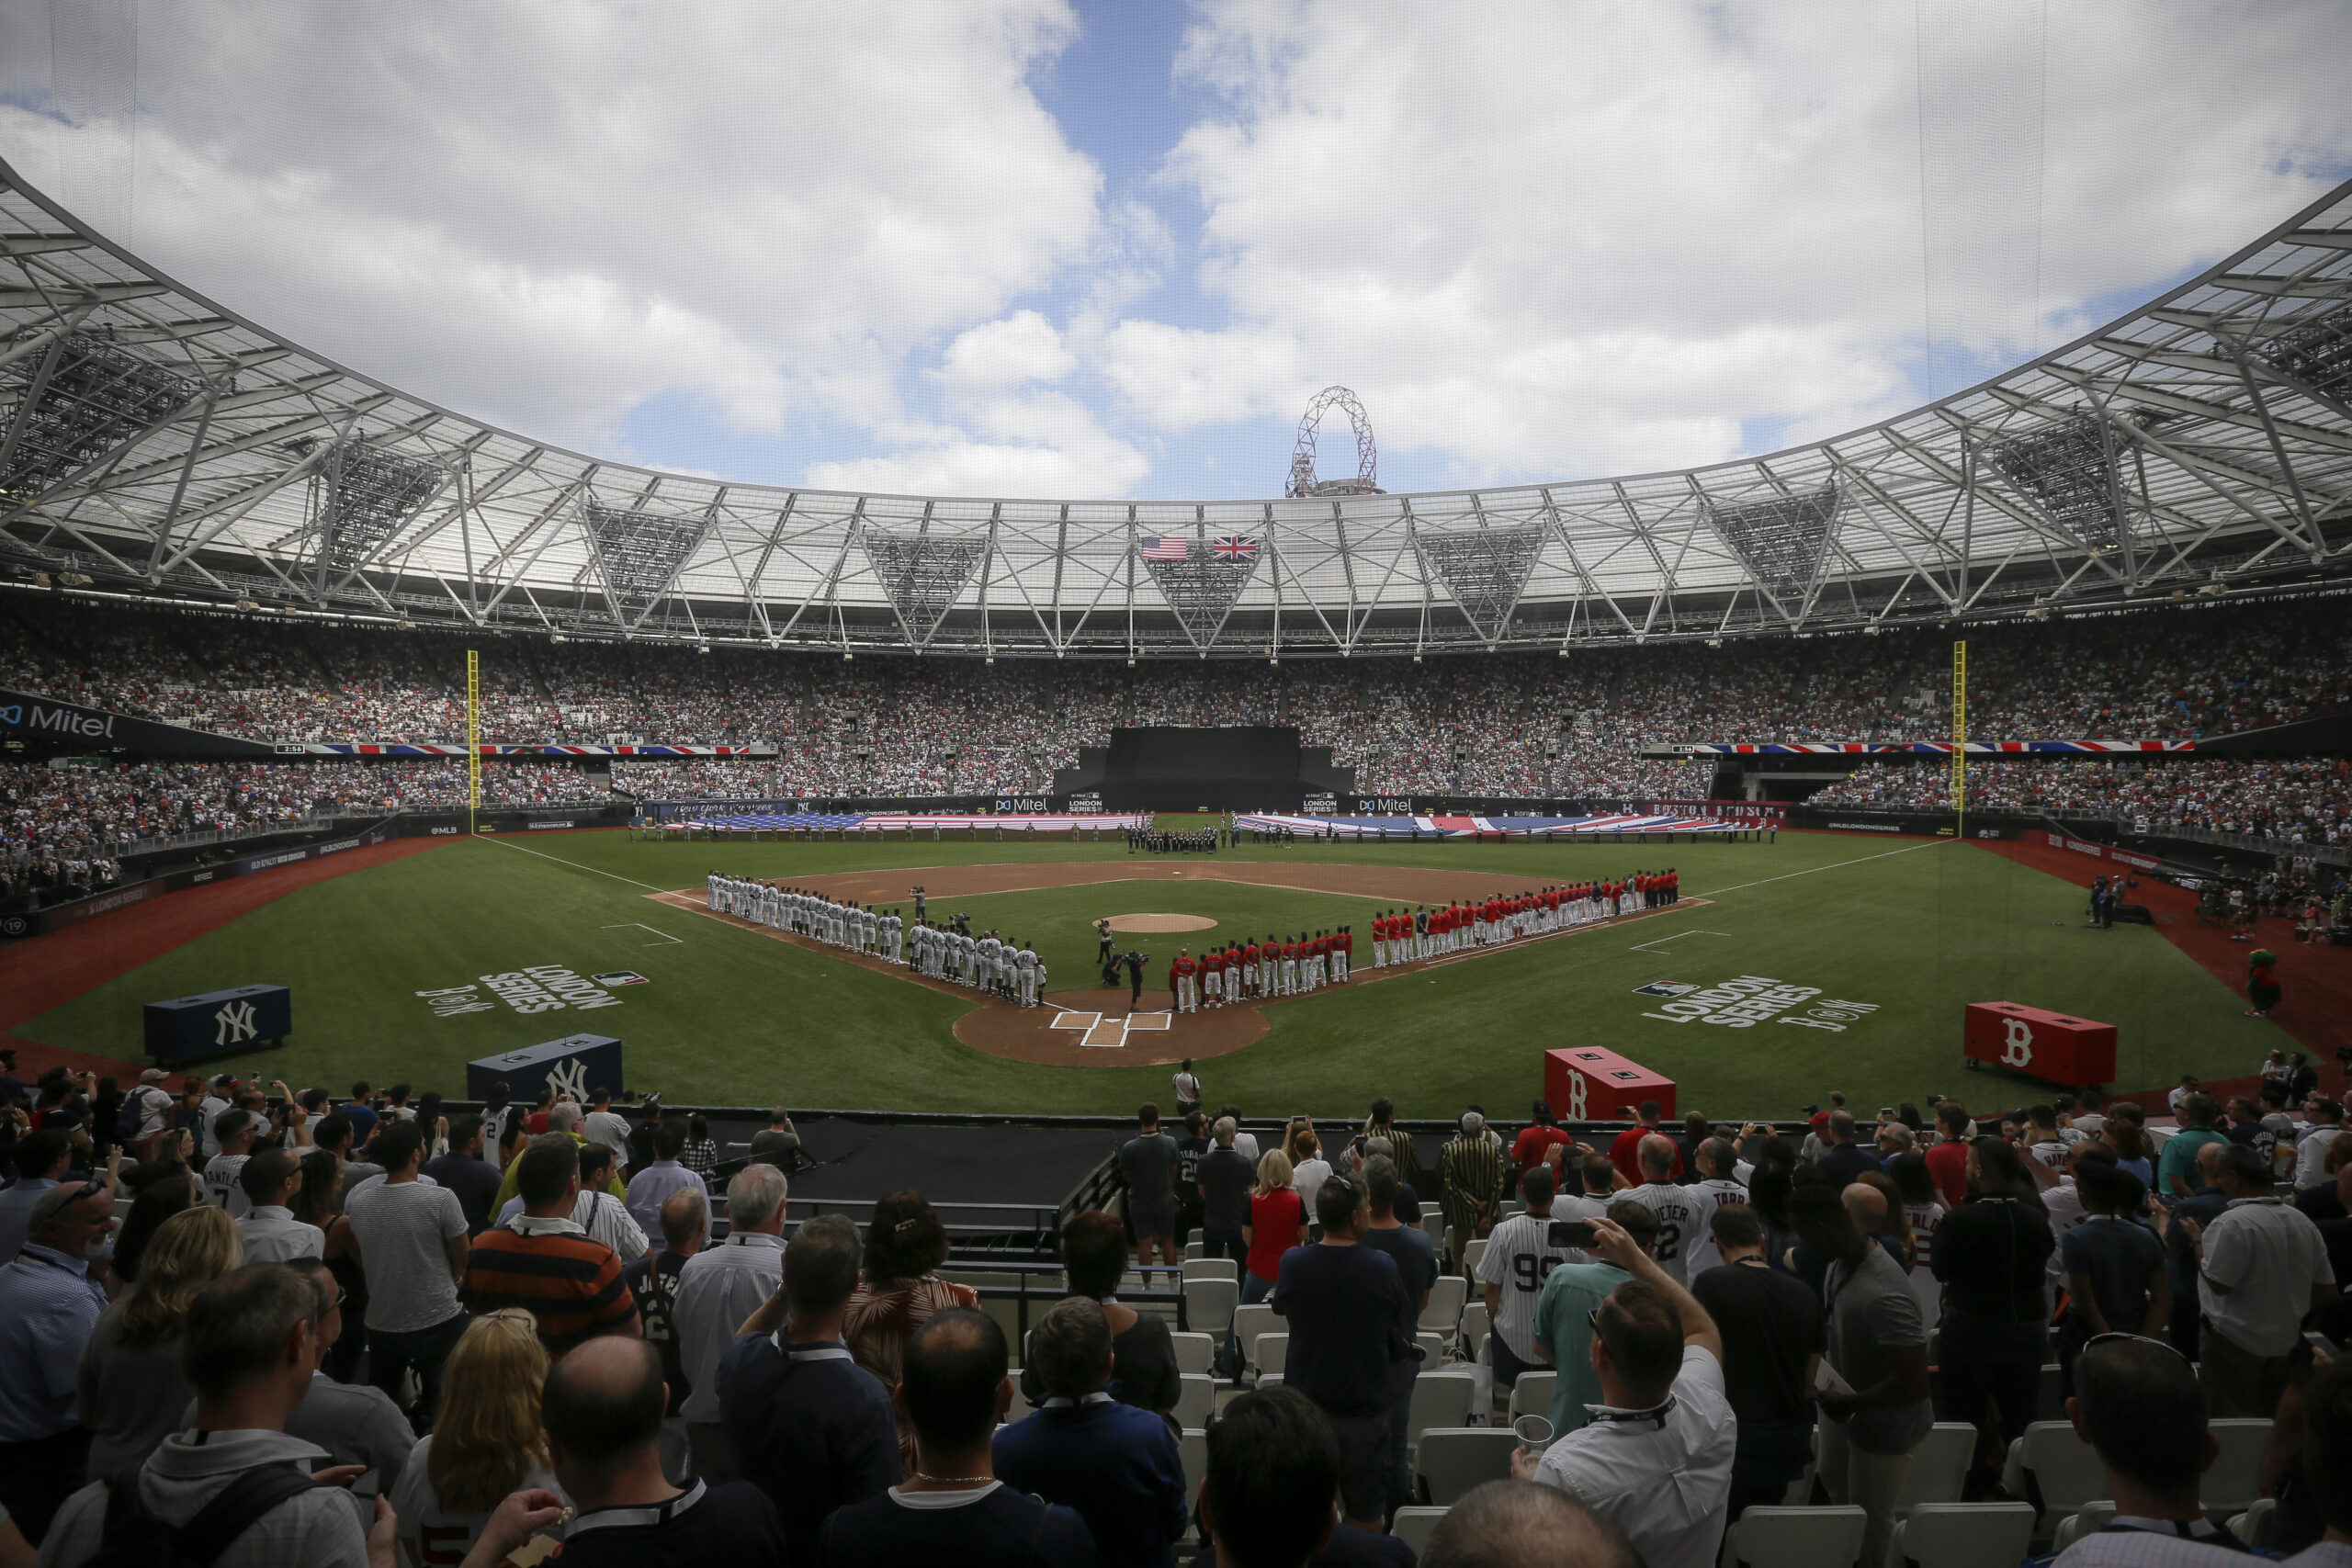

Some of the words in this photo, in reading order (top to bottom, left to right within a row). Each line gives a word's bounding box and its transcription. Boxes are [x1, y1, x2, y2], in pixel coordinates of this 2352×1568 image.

[29, 705, 114, 739] Mitel
[699, 804, 725, 817] York
[1013, 797, 1047, 811] Mitel
[1378, 797, 1412, 812] Mitel
[431, 827, 458, 835] @MLB
[95, 895, 123, 912] LONDON
[7, 920, 22, 931] 19
[1022, 954, 1030, 963] 17
[479, 972, 567, 1014] SERIES
[521, 964, 625, 1010] LONDON
[1640, 975, 1782, 1023] LONDON
[1702, 984, 1823, 1028] SERIES
[215, 999, 258, 1046] NY
[2000, 1018, 2034, 1067] B
[545, 1057, 590, 1103] NY
[1566, 1068, 1588, 1122] B
[487, 1122, 496, 1139] 2
[204, 1170, 240, 1189] MANTLE
[214, 1188, 229, 1209] 7
[1657, 1224, 1680, 1261] 2
